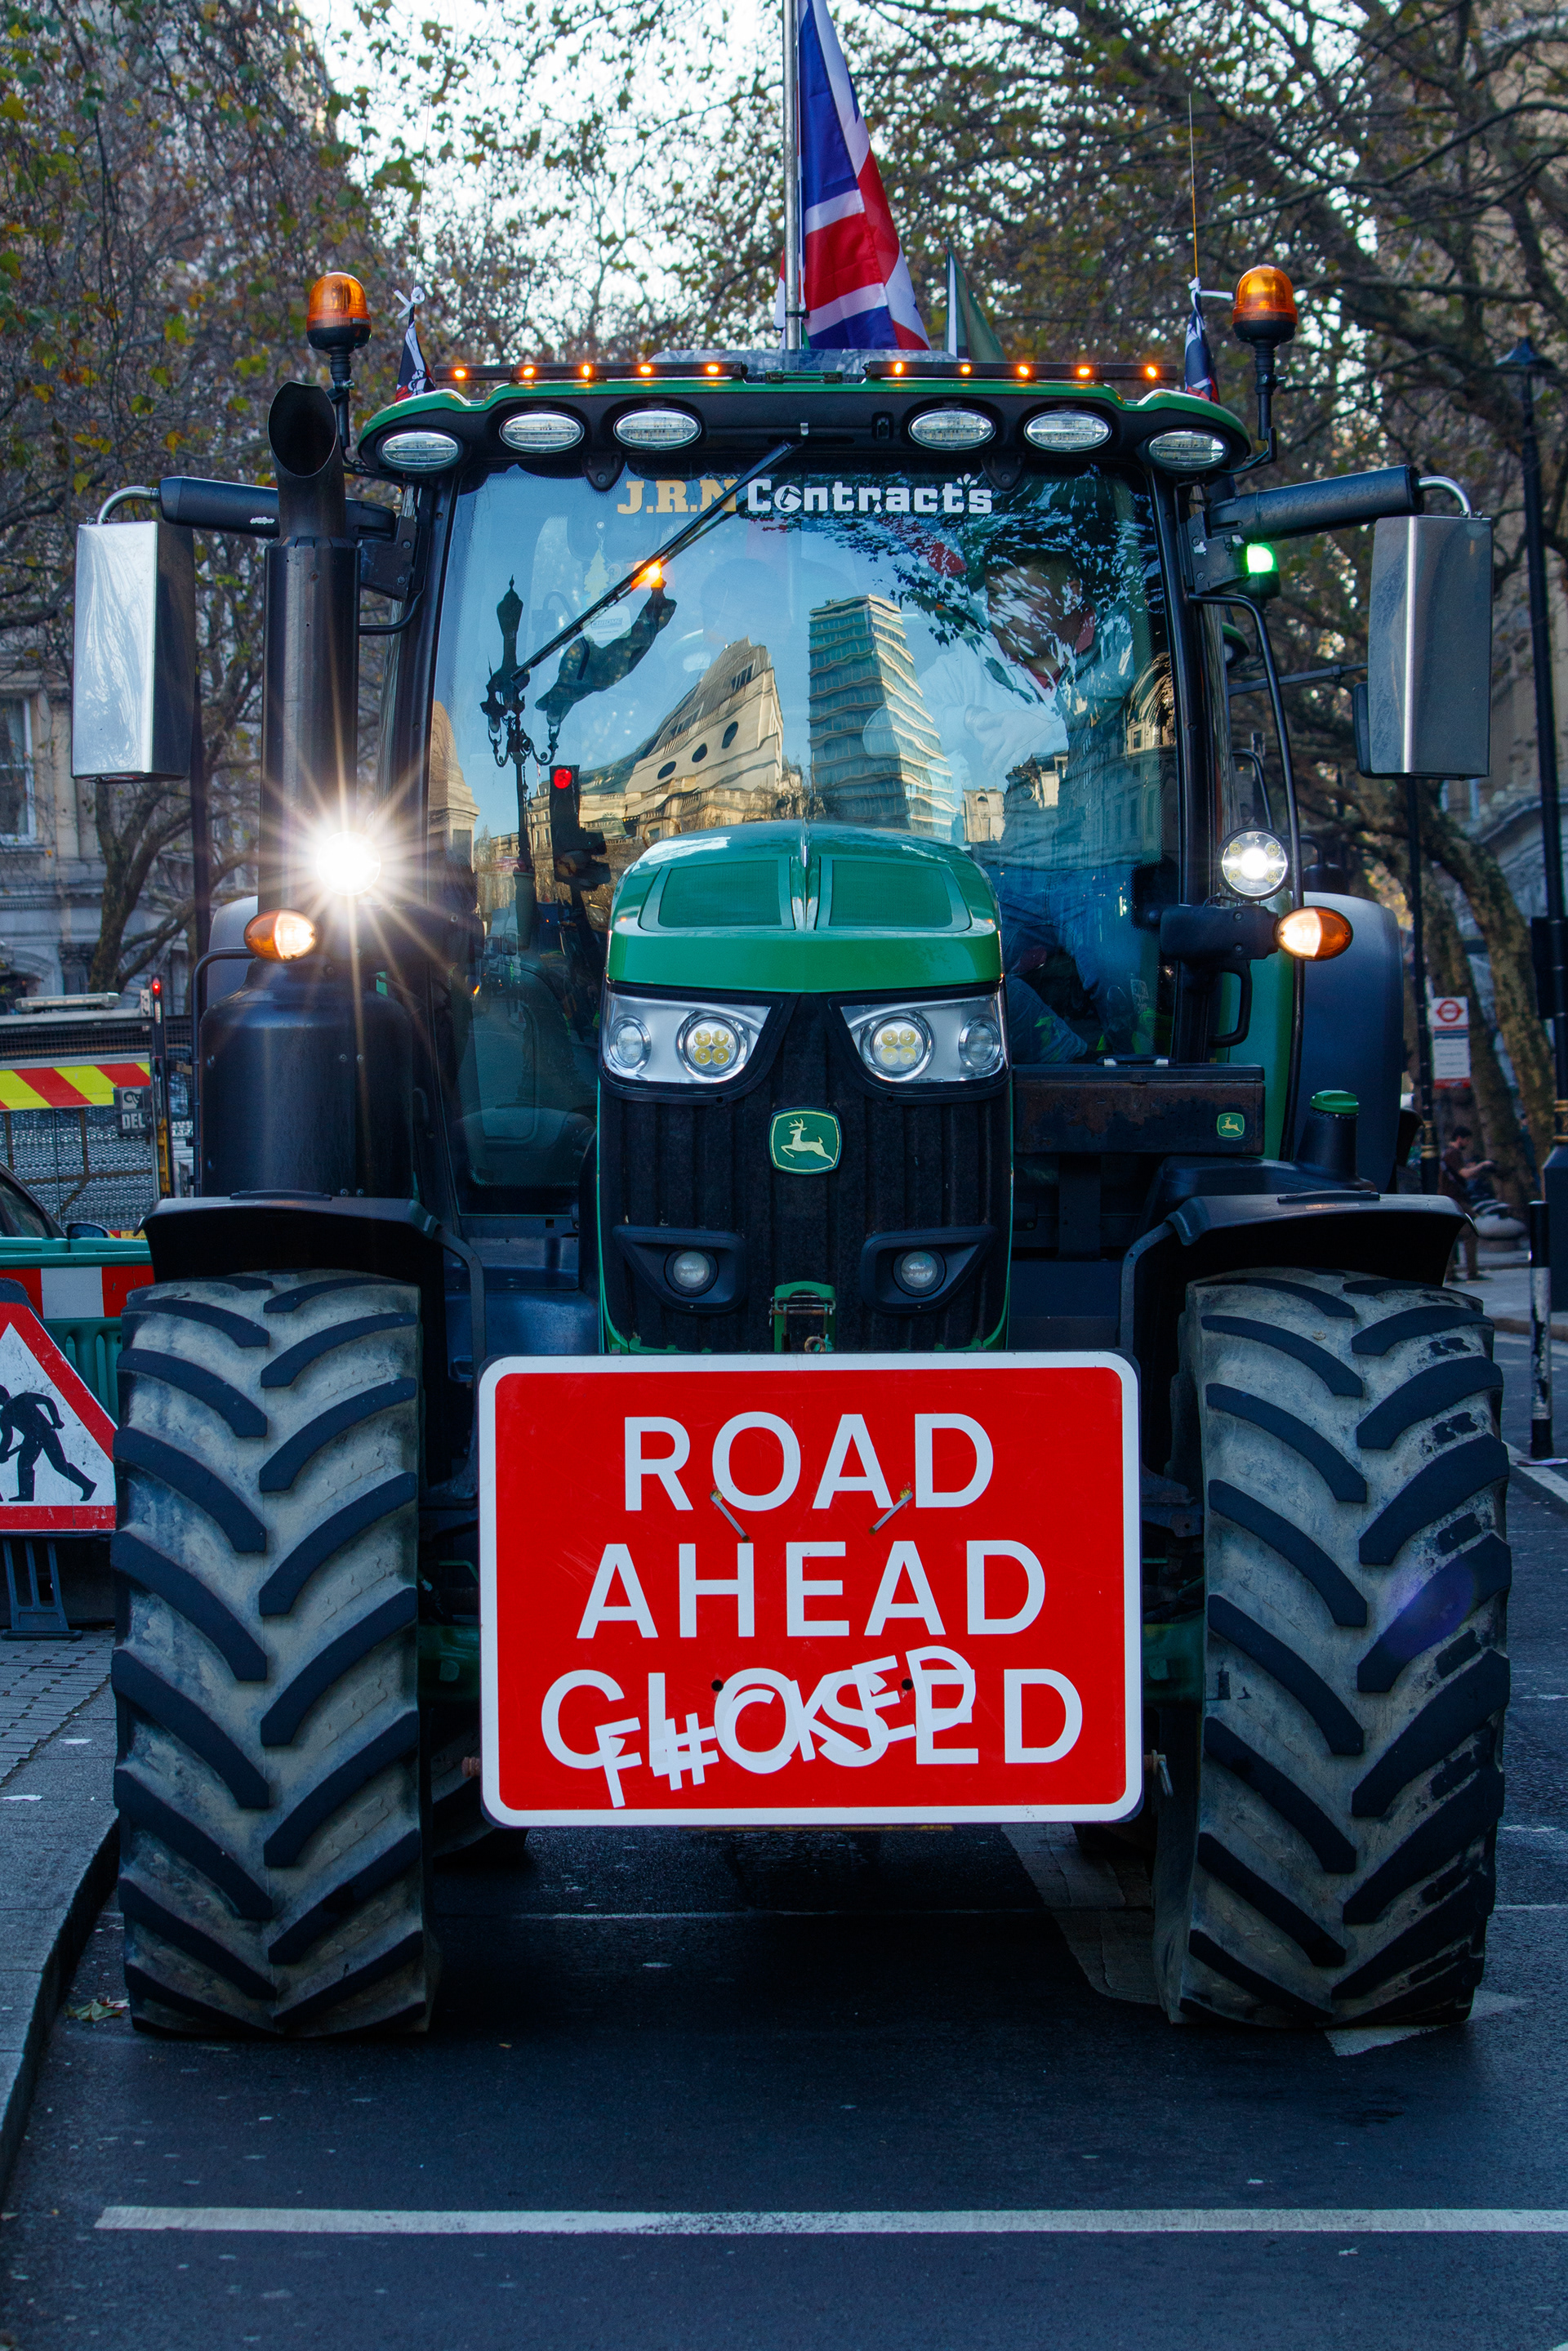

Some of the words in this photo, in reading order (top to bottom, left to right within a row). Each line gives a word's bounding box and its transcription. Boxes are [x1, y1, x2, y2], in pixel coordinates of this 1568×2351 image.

[617, 479, 737, 514] J.R.N
[122, 1112, 145, 1129] DEL
[624, 1411, 994, 1512] ROAD
[577, 1540, 1045, 1639] AHEAD
[541, 1668, 1084, 1770] CLOSED
